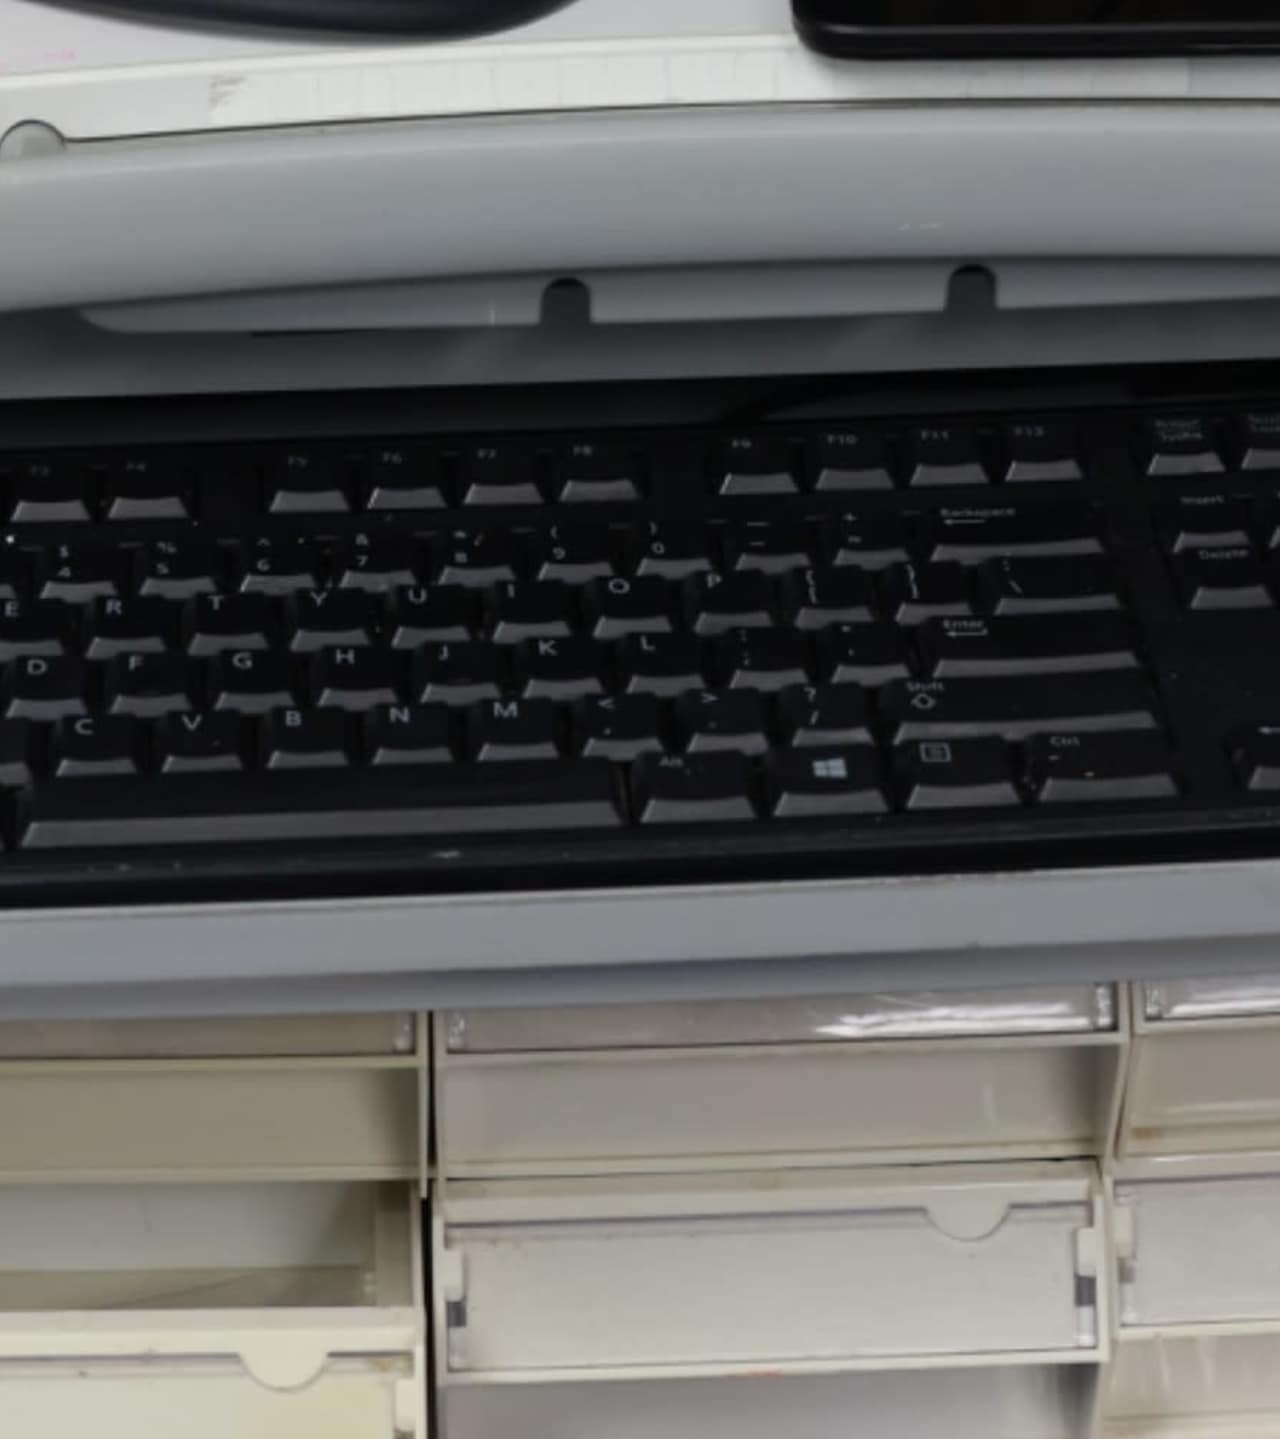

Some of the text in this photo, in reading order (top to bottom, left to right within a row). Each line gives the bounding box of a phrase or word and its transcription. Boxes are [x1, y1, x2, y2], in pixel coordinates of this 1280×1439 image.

[552, 546, 567, 560] 9
[256, 558, 271, 572] 6
[607, 577, 631, 595] O
[705, 571, 723, 589] P
[207, 595, 225, 611] T
[309, 592, 328, 608] Y
[407, 588, 428, 606] U
[4, 600, 20, 618] E
[106, 598, 123, 616] R
[537, 639, 559, 657] K
[640, 635, 656, 652] L
[128, 654, 145, 671] F
[231, 651, 254, 670] G
[334, 647, 356, 666] H
[437, 645, 449, 662] J
[25, 658, 48, 675] D
[284, 710, 303, 727] B
[389, 706, 411, 724] N
[493, 701, 519, 719] M
[73, 717, 95, 736] C
[180, 713, 204, 731] V
